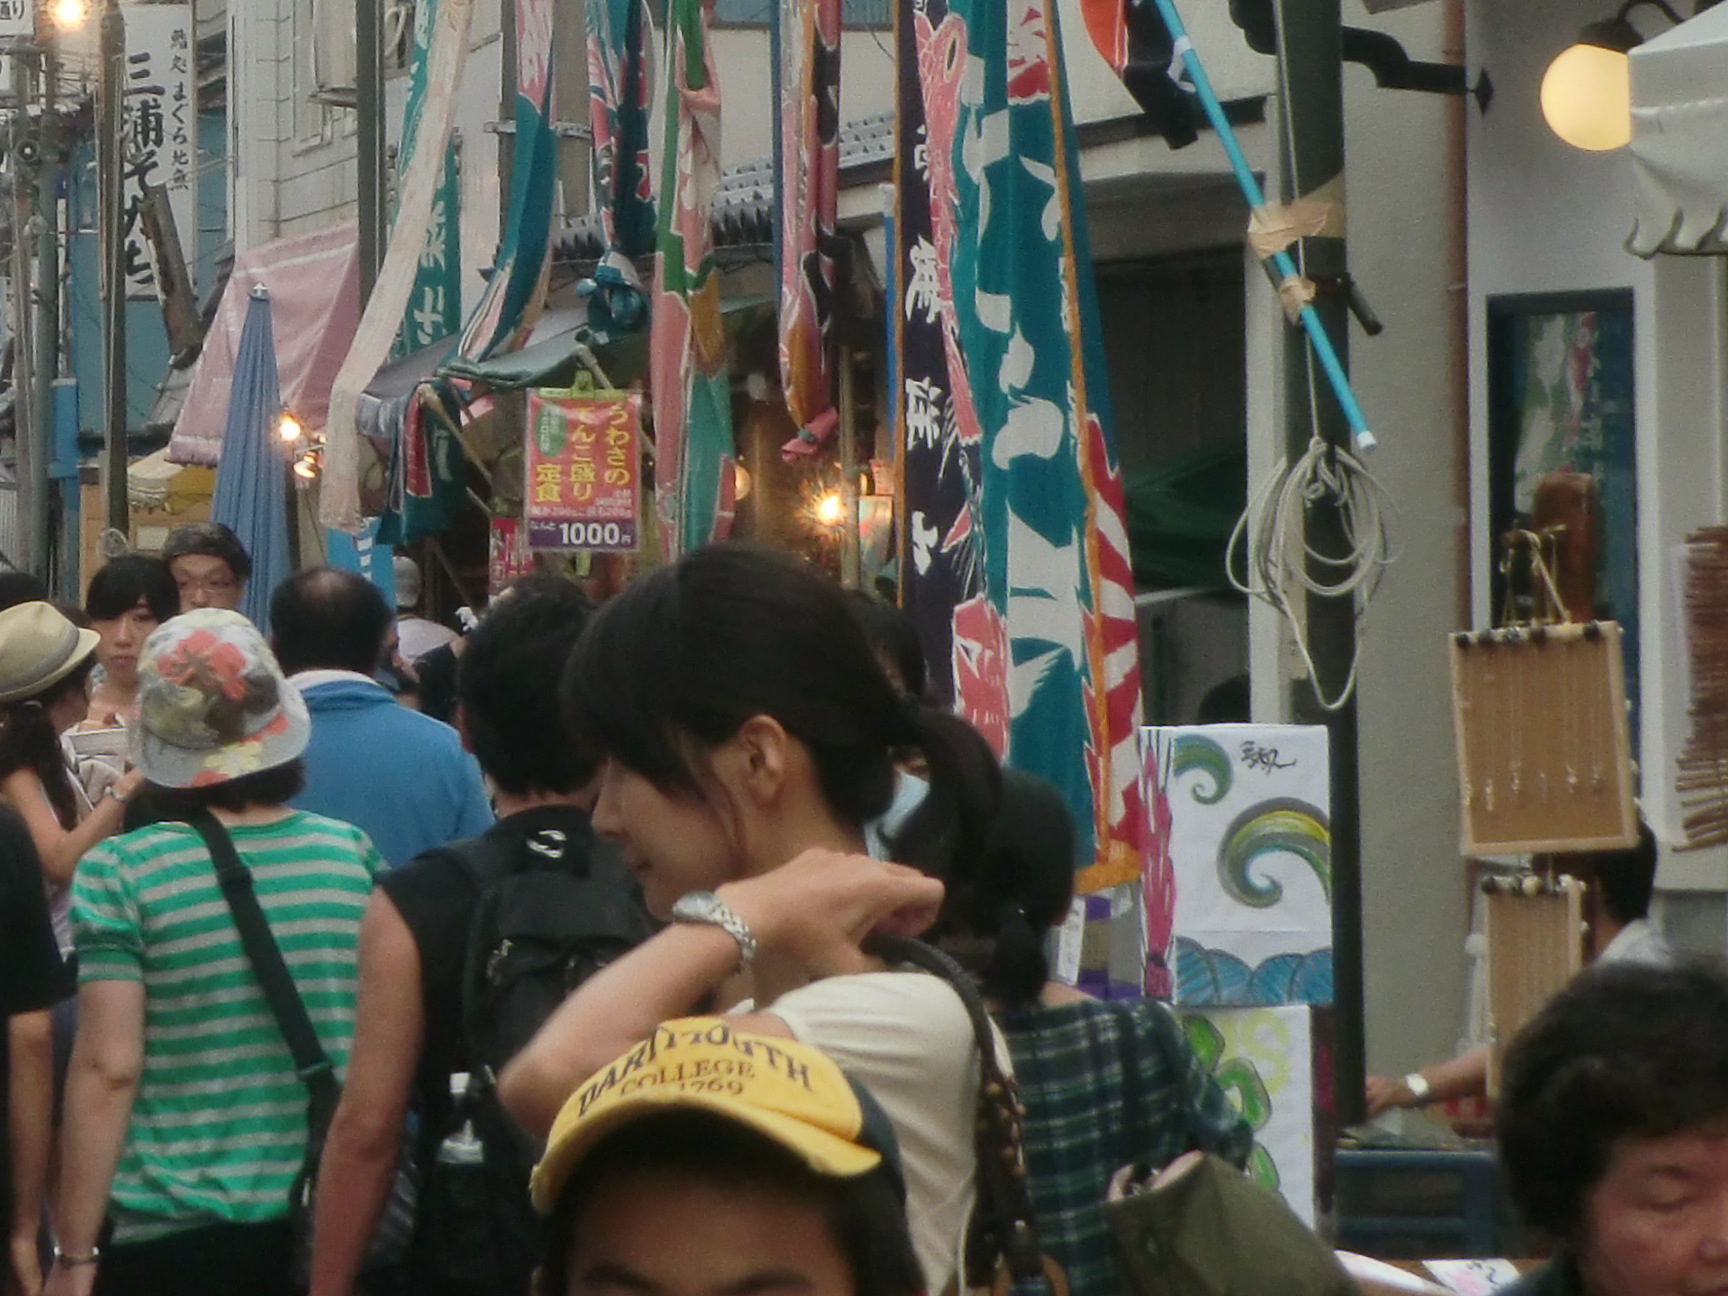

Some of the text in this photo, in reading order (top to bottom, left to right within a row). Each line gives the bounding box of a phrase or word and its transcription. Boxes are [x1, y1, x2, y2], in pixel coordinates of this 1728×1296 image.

[535, 462, 562, 503] 定食
[621, 1058, 755, 1096] COLLEGE
[679, 1077, 744, 1096] 1769
